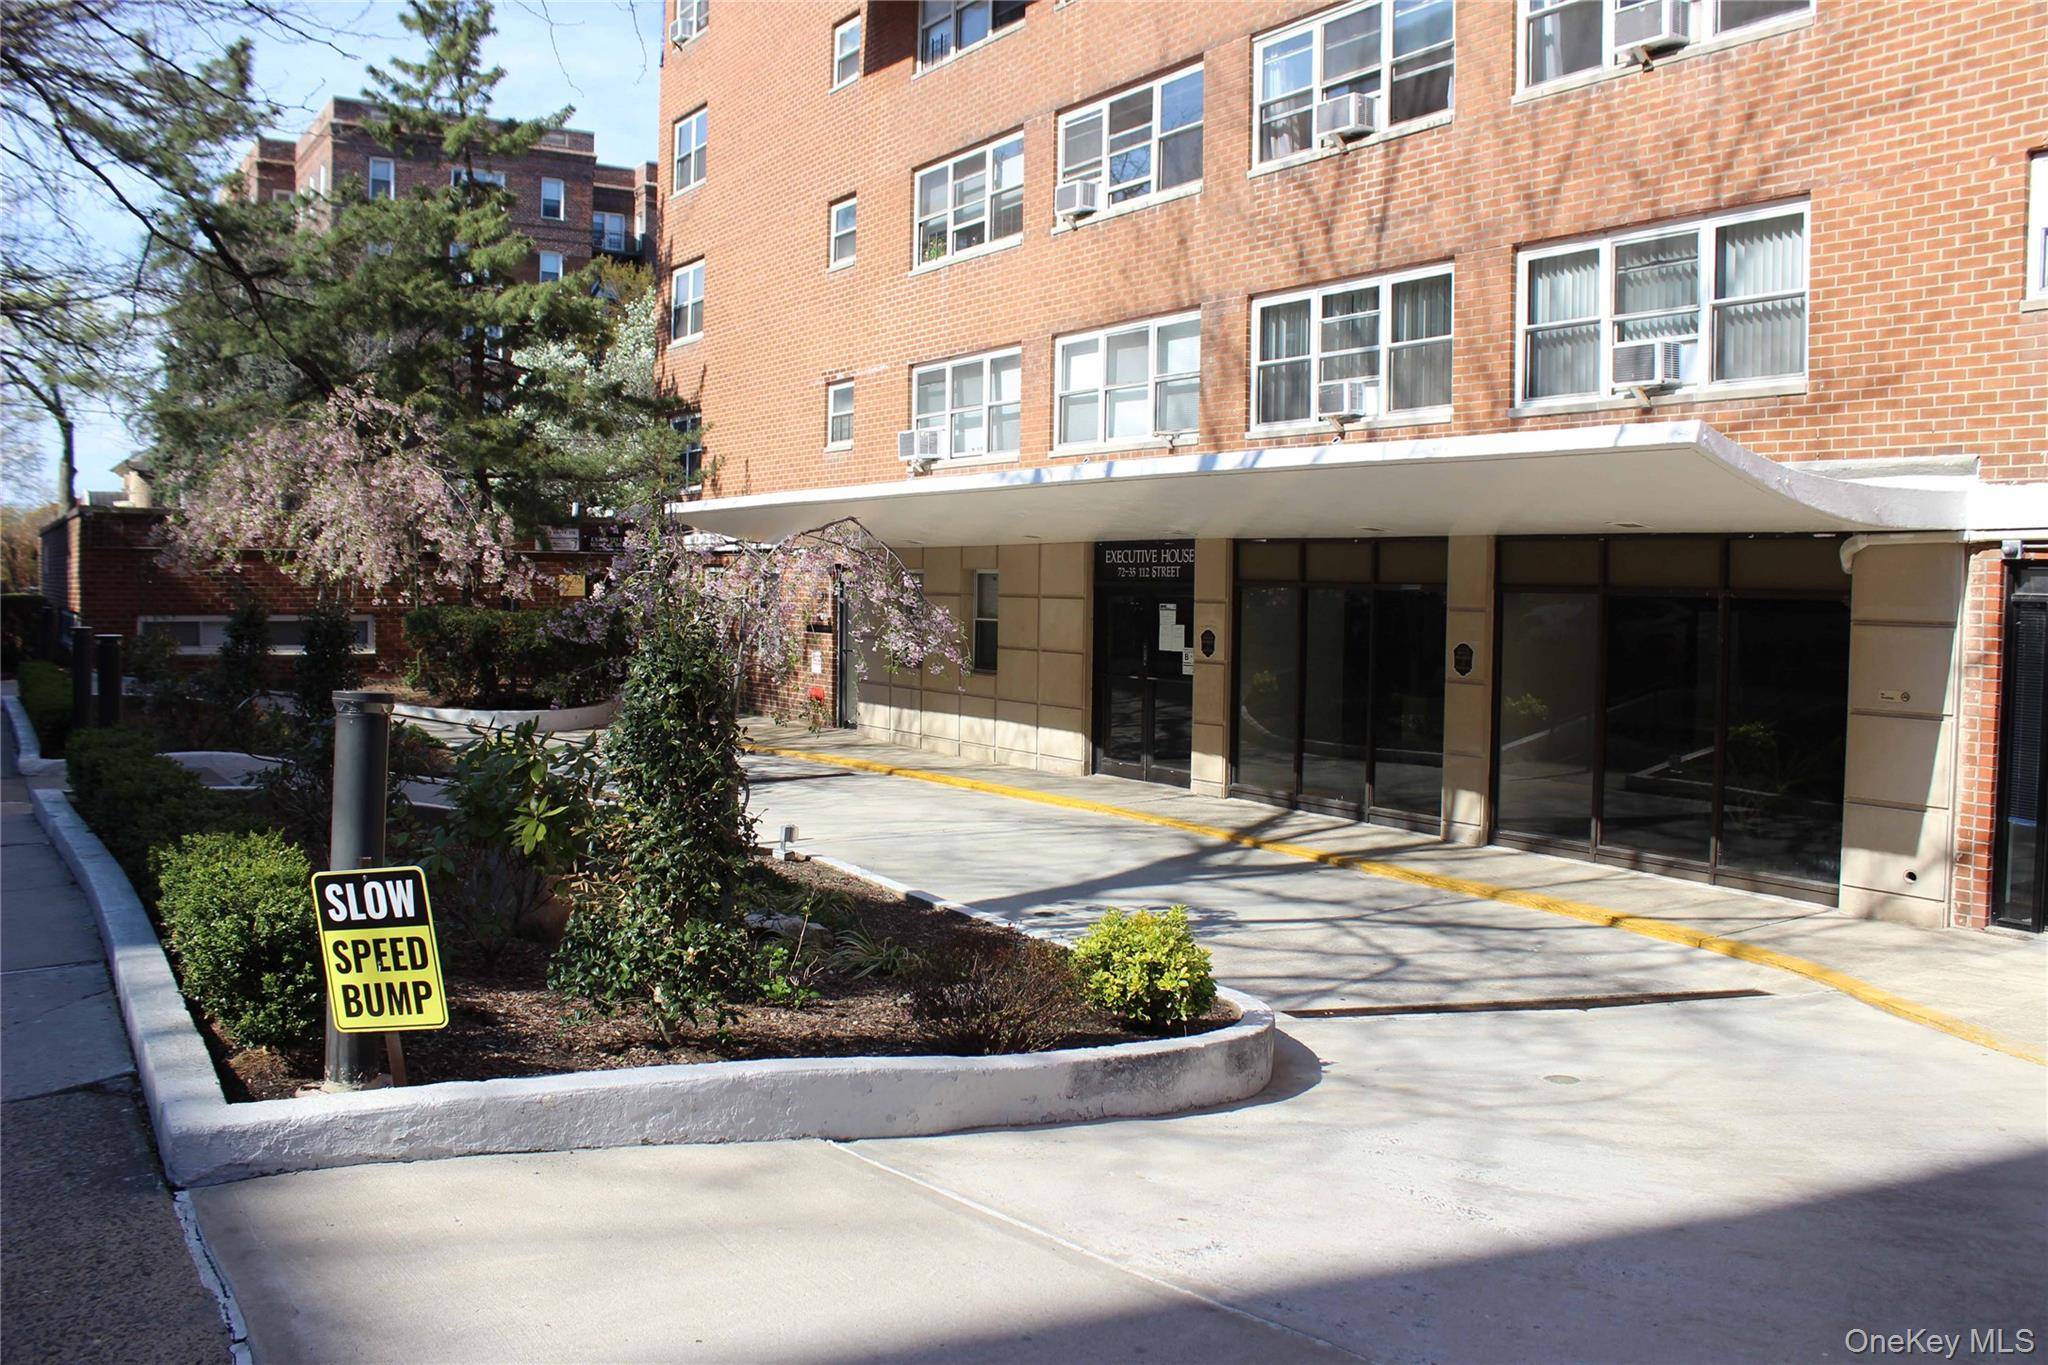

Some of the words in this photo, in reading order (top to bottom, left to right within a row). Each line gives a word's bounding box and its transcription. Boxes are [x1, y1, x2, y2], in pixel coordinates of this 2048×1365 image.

[1105, 549, 1157, 563] EXECUTIVE
[1161, 548, 1195, 563] HOUSE
[1117, 567, 1136, 577] 72-35
[1139, 567, 1150, 577] 112
[1151, 566, 1181, 577] STREET
[325, 879, 416, 922] SLOW
[332, 936, 429, 974] SPEED
[341, 981, 433, 1018] BUMP
